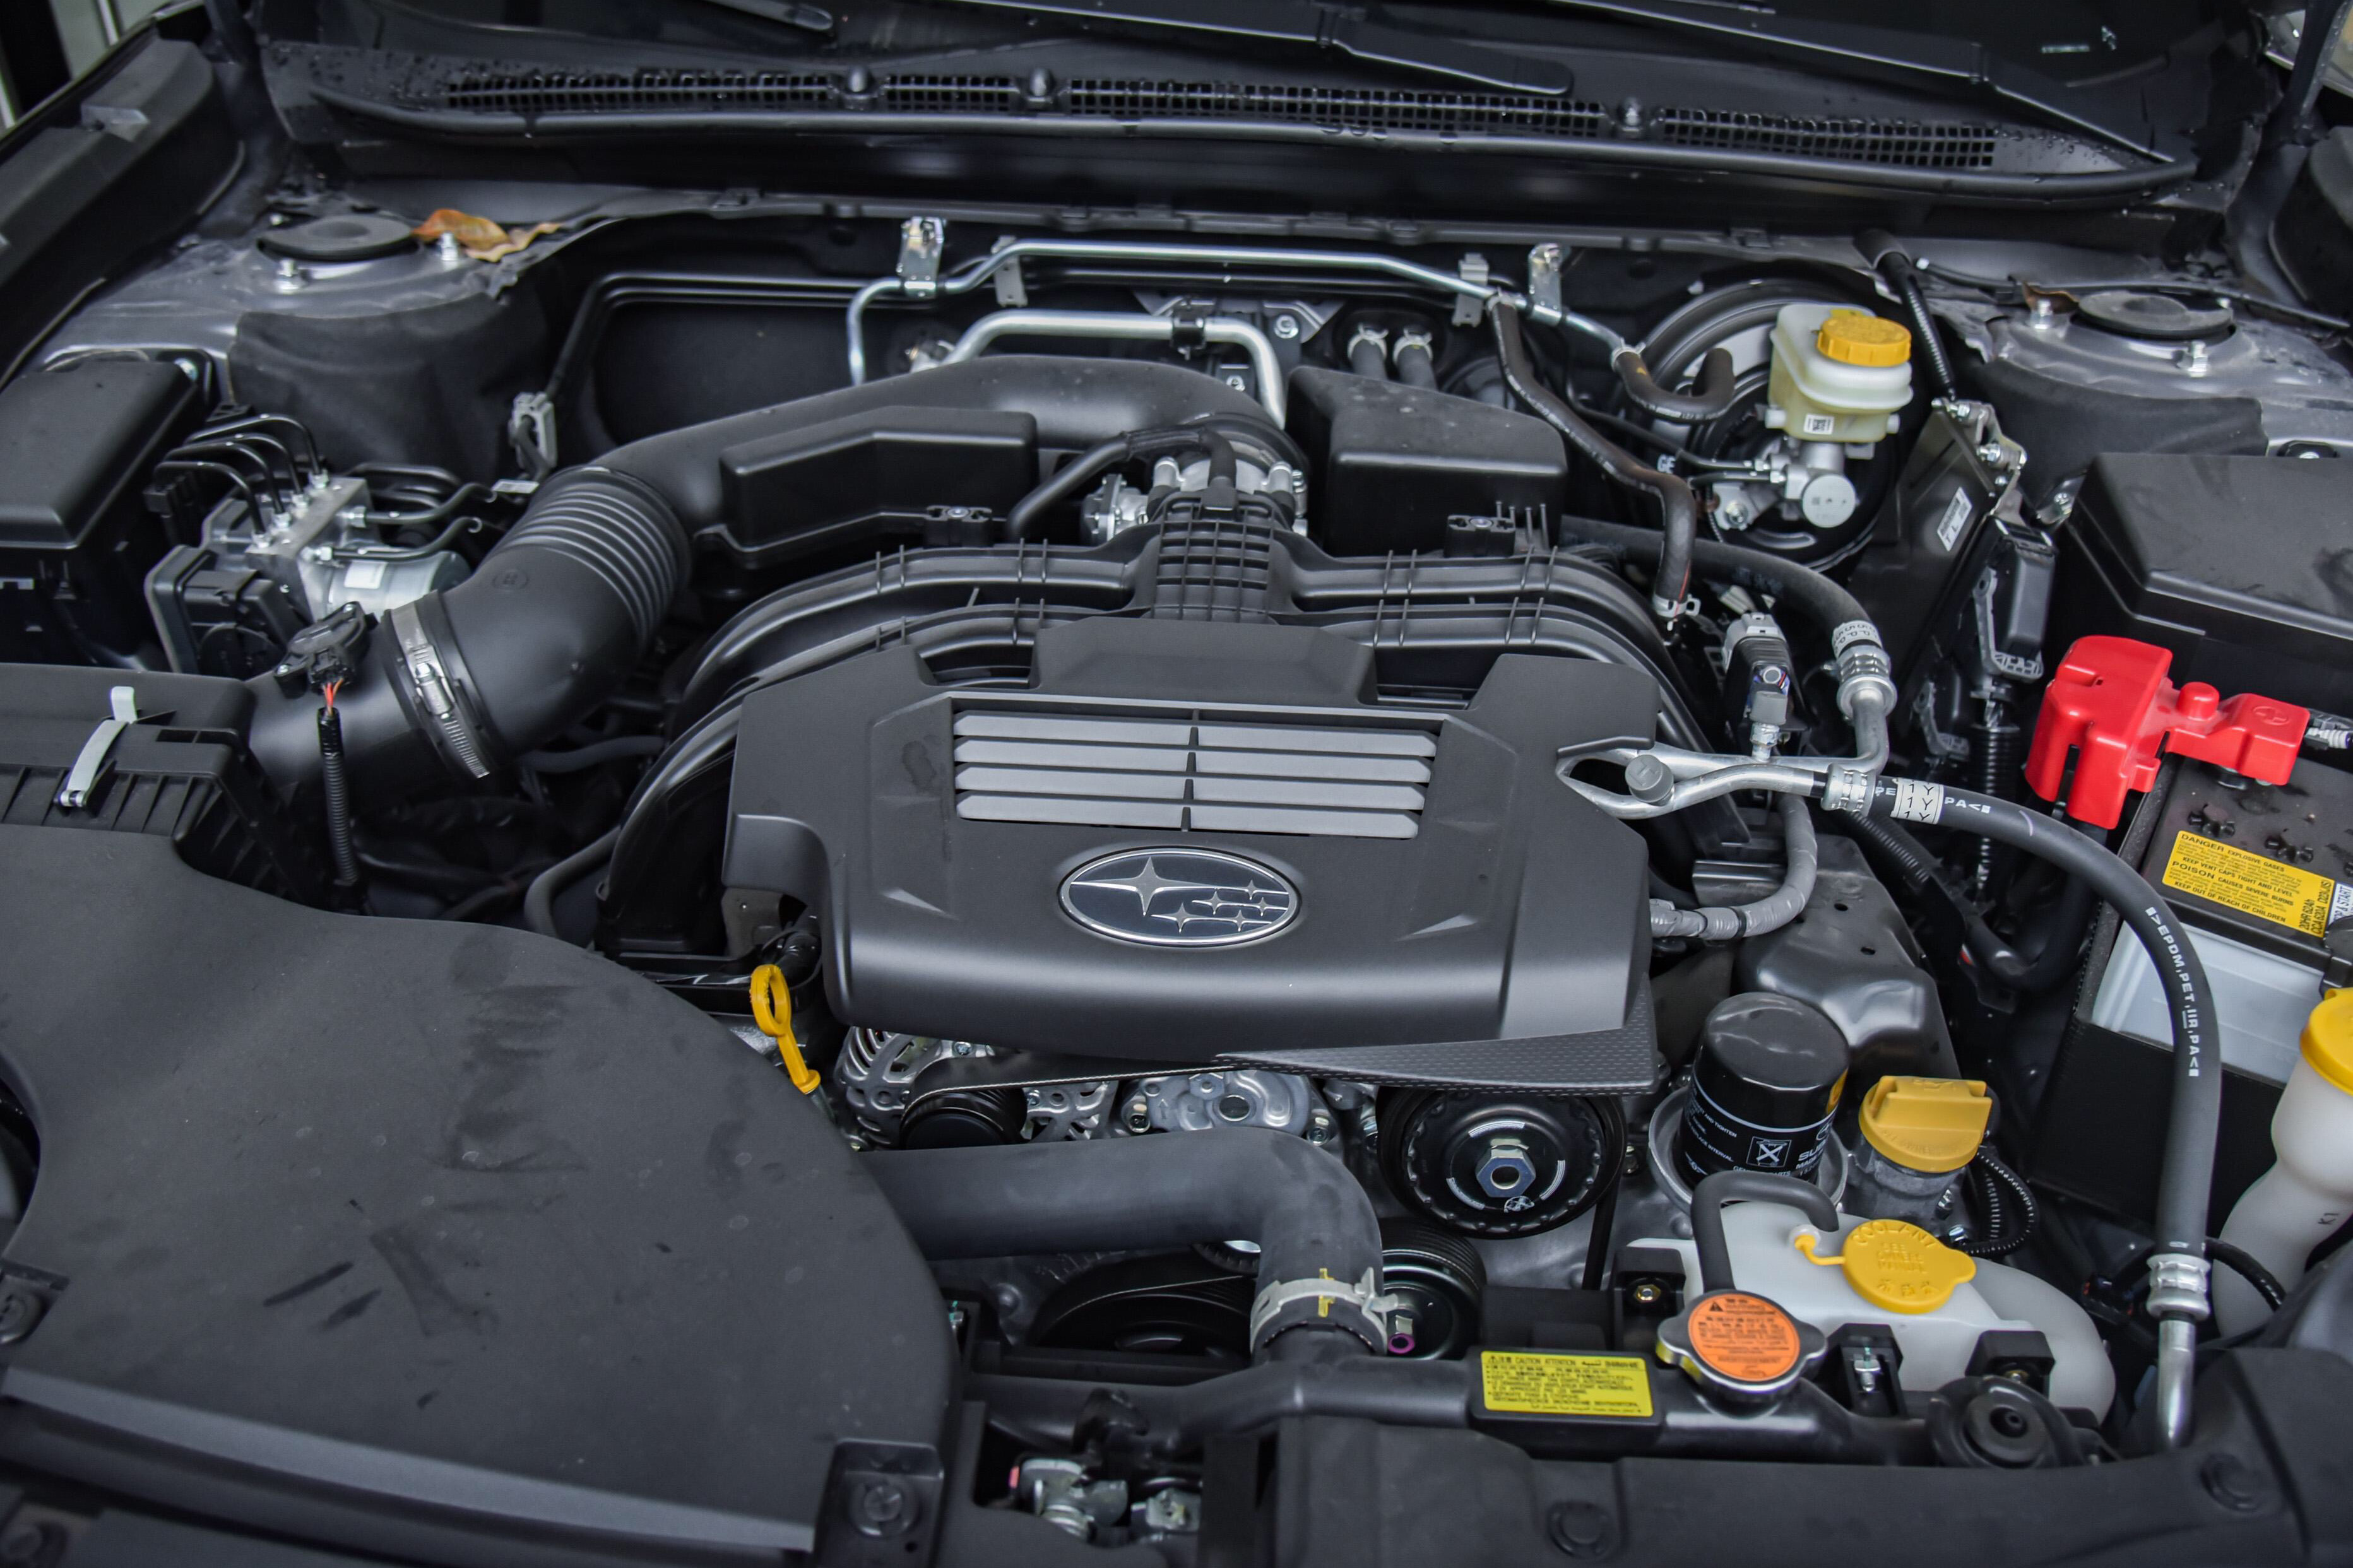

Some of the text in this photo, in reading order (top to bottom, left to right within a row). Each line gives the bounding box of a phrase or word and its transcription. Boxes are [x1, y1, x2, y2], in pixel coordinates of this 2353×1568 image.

[2181, 833, 2285, 873] DANGER EXPLOSIVE GASES
[2171, 861, 2215, 880] POISON
[2217, 876, 2244, 889] CAUSES
[2245, 885, 2269, 898] SEVERE
[2272, 895, 2294, 907] BURNS
[2182, 856, 2294, 897] KEEP VENT CAPS TIGHT AND LEVEL
[2174, 881, 2192, 892] KEEP
[2192, 887, 2207, 896] OUT
[2217, 894, 2241, 907] REACH
[2241, 903, 2251, 911] OF
[2251, 906, 2287, 923] CHILDREN
[1852, 1221, 1936, 1247] COOLANT
